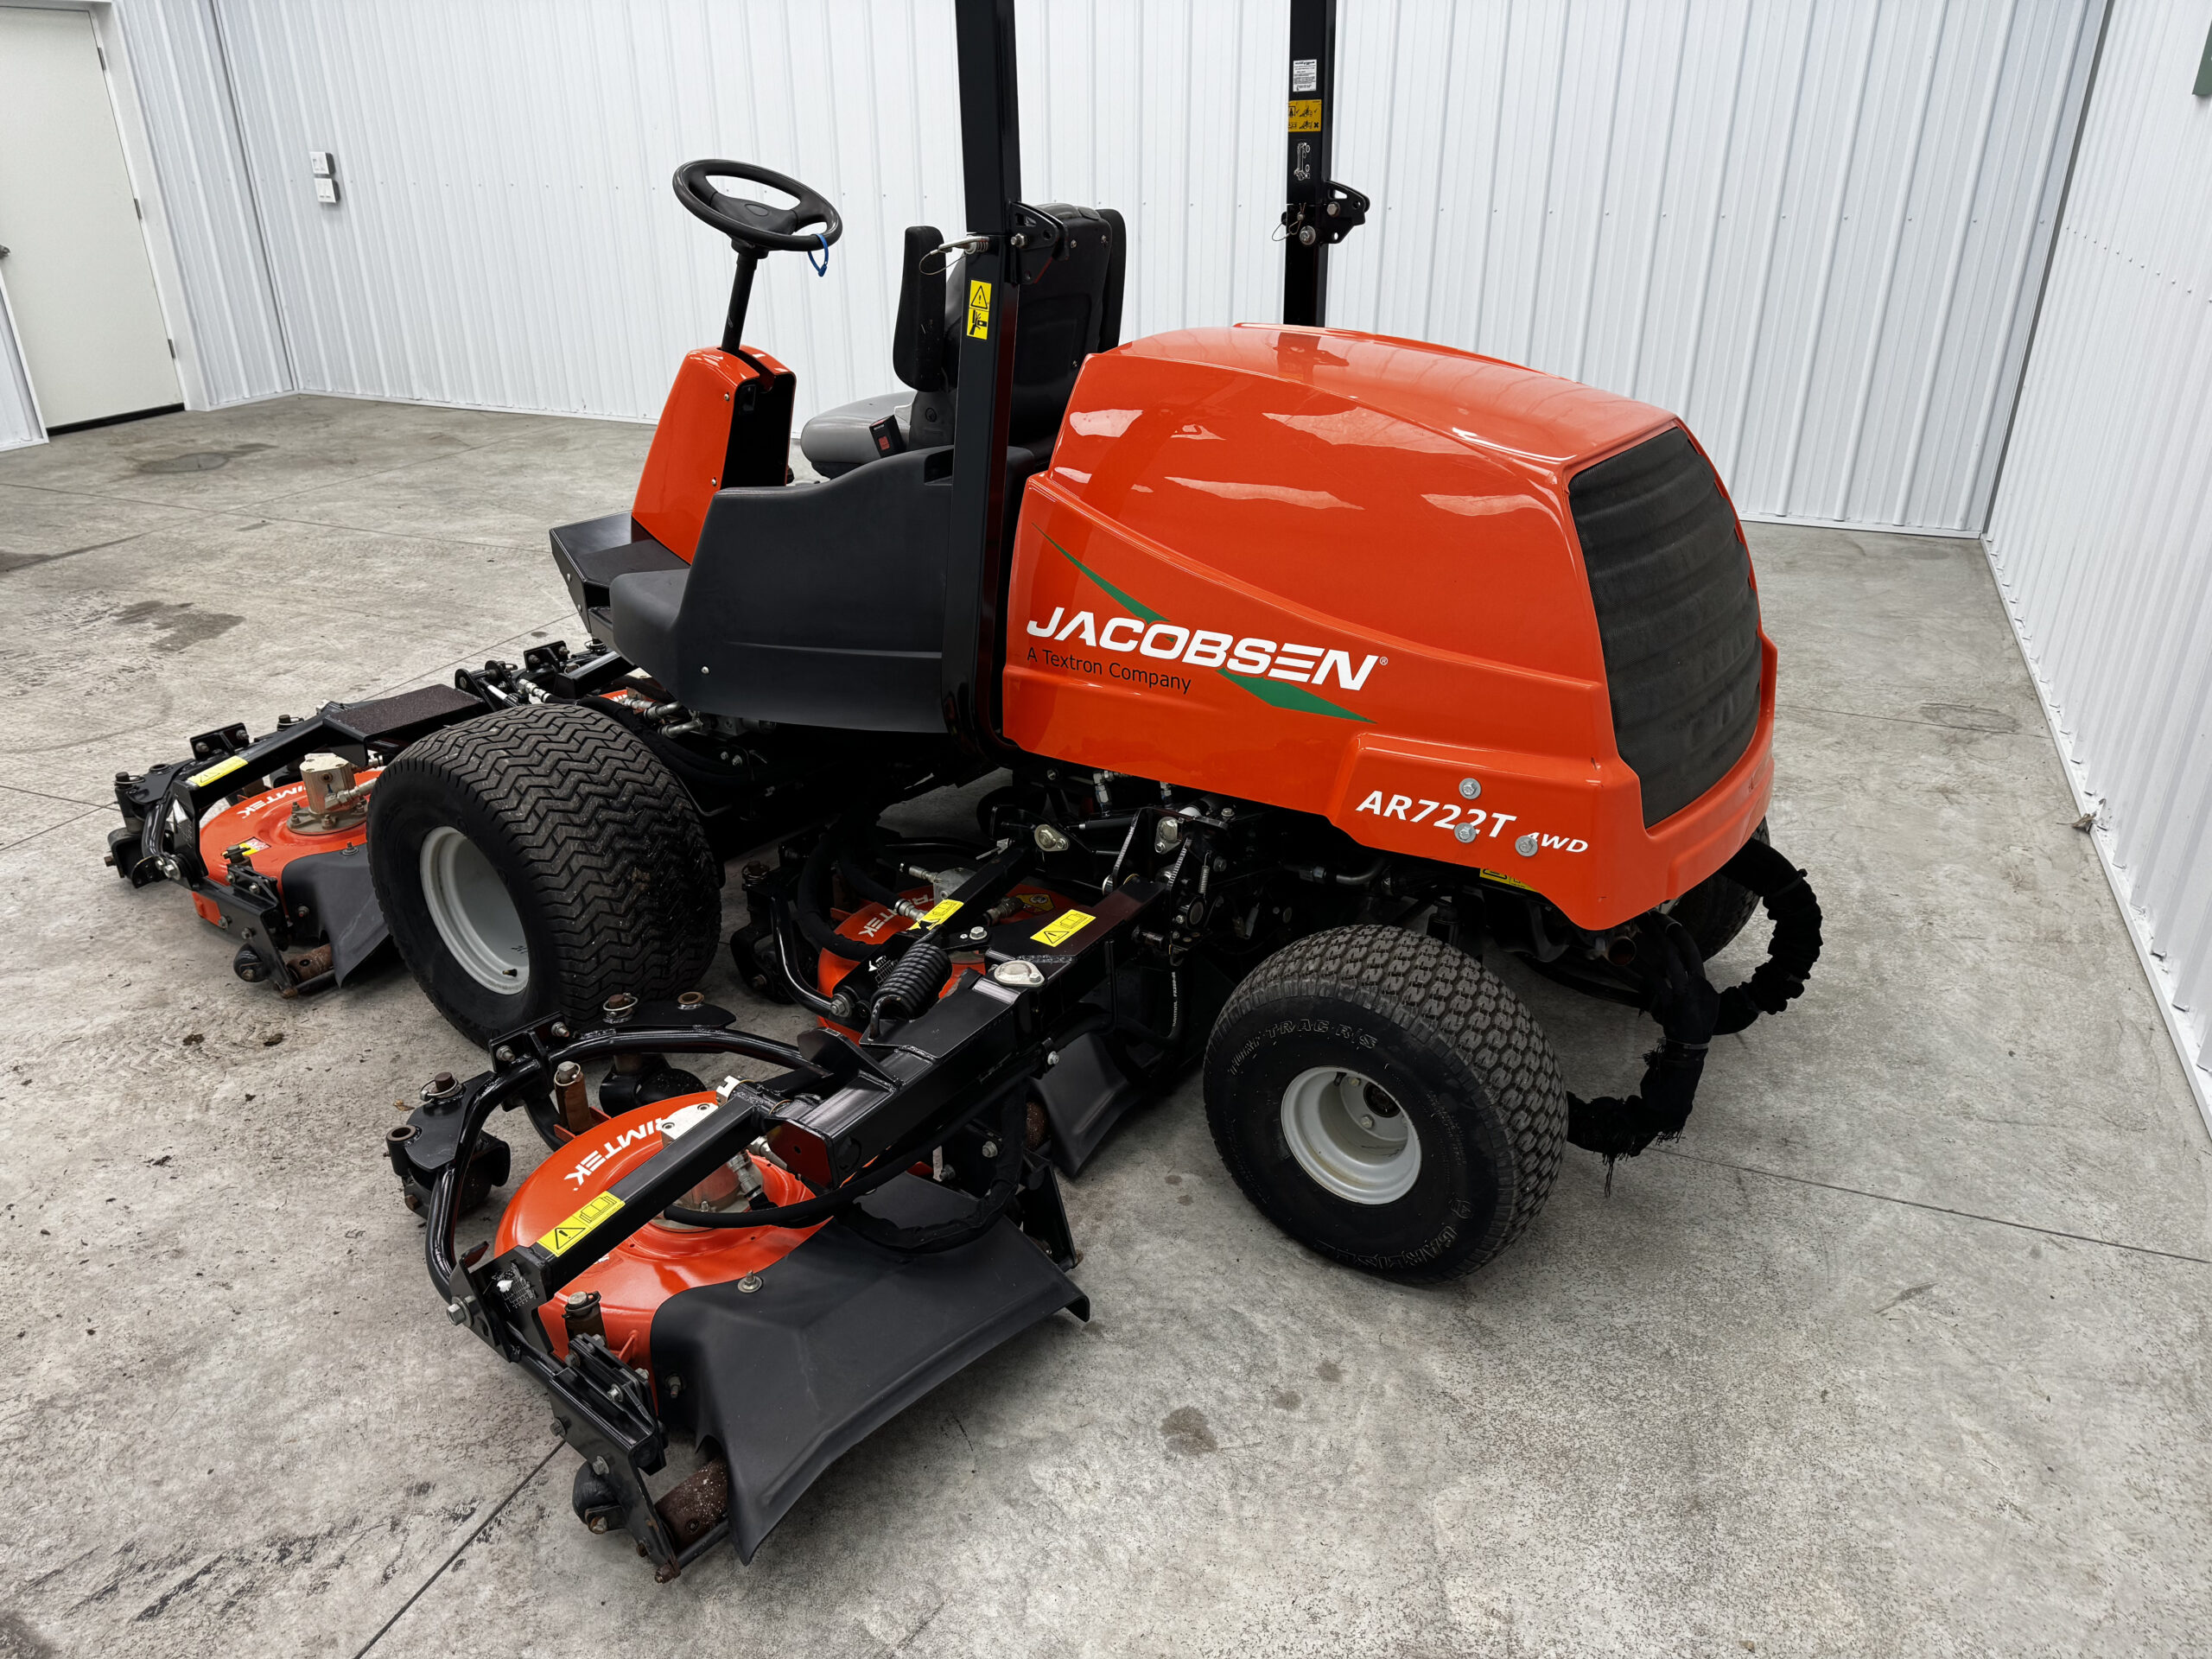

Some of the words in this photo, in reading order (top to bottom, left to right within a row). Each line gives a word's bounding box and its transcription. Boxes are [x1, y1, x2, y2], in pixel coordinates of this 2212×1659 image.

[1027, 646, 1038, 663] A
[1042, 649, 1103, 675] Textron
[1109, 662, 1192, 695] Company
[1355, 790, 1517, 838] AR722T
